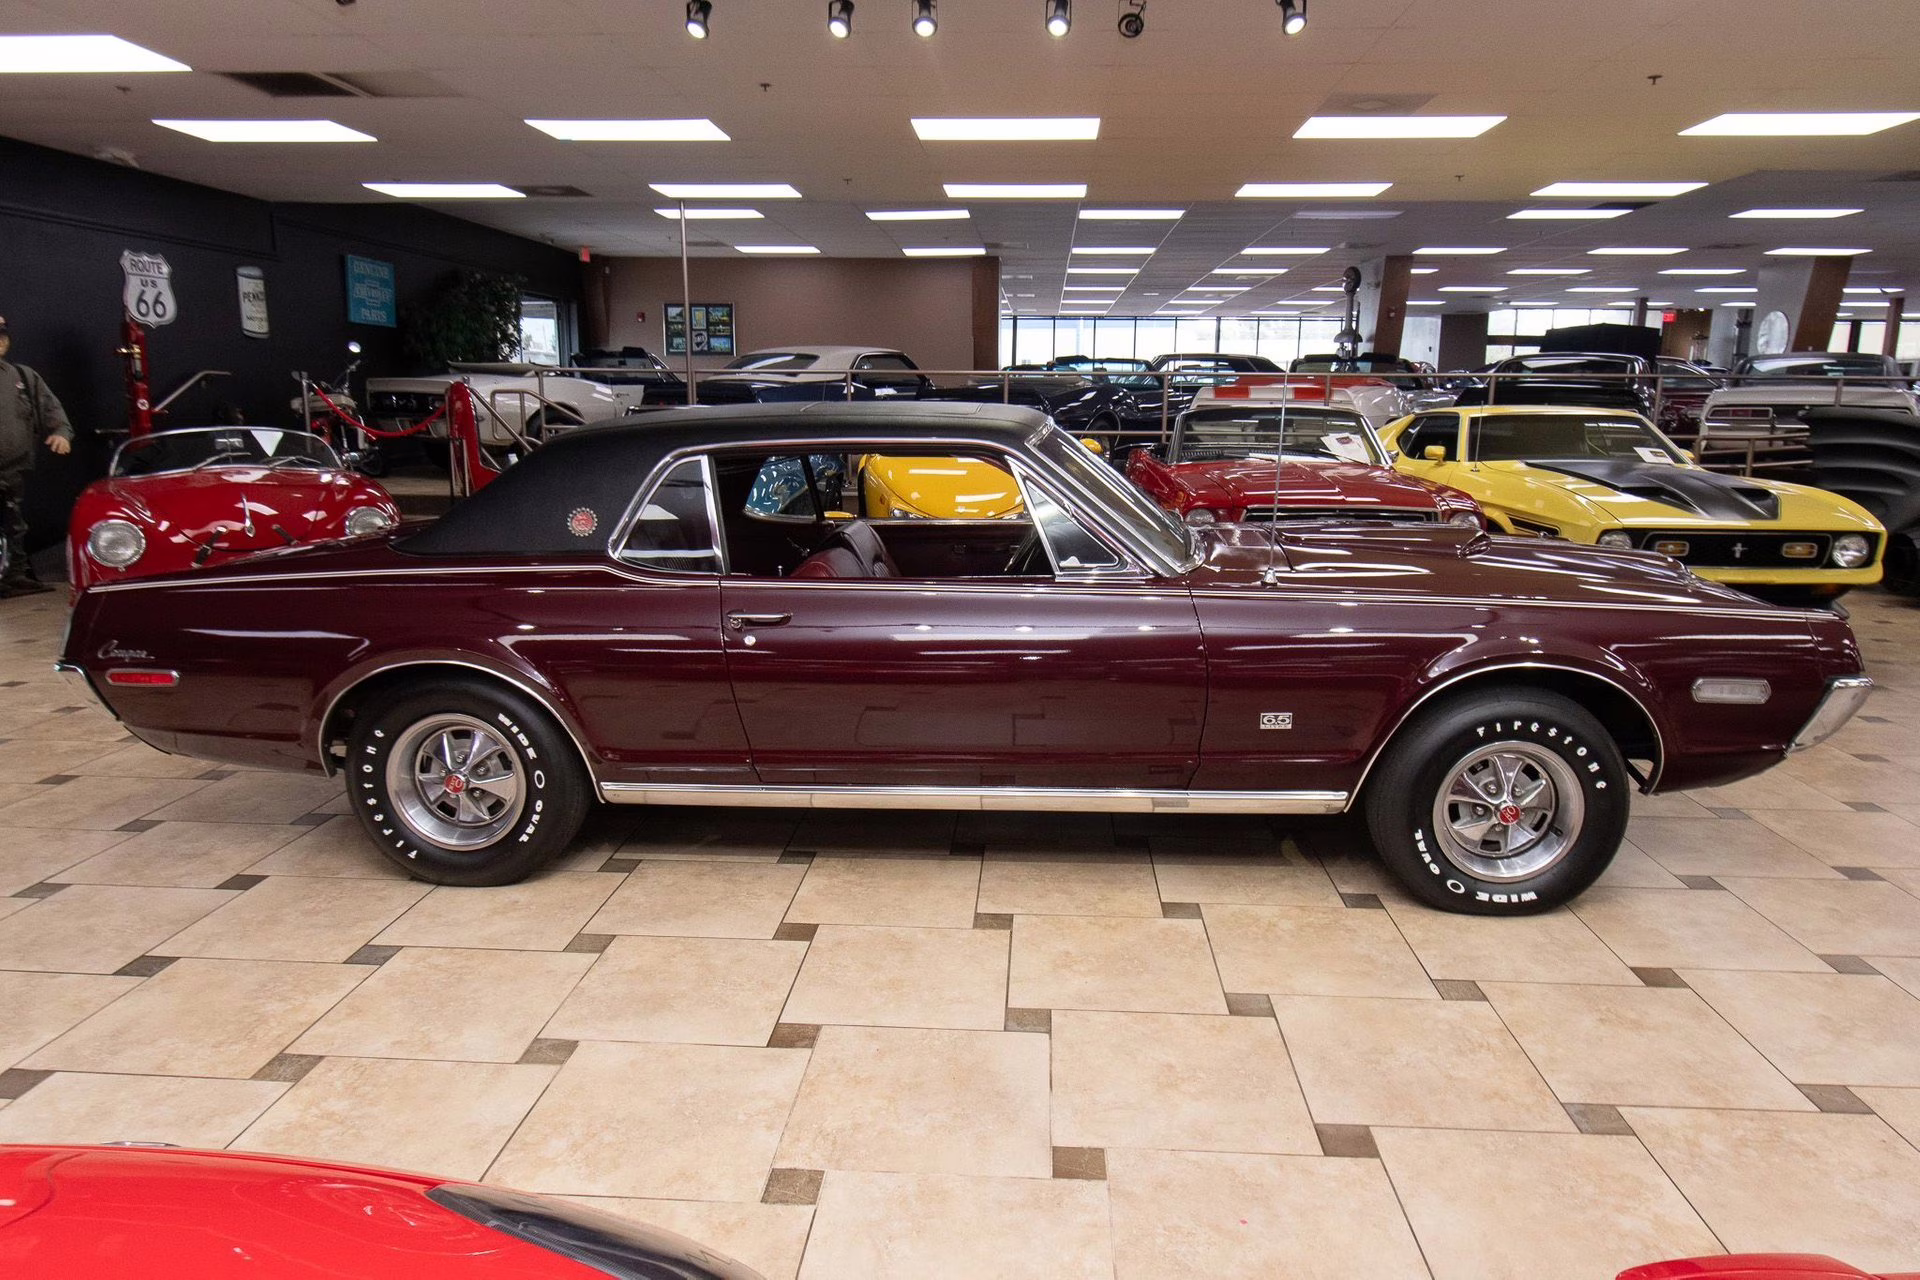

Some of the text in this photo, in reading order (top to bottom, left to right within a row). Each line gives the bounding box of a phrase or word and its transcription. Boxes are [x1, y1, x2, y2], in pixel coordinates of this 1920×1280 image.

[129, 259, 163, 275] ROUTE
[141, 279, 158, 288] US
[136, 289, 167, 318] 66
[361, 309, 387, 322] PARTS
[1262, 715, 1290, 725] 6.5
[497, 713, 537, 760] WIDE
[519, 799, 544, 843] OVAL
[1414, 828, 1441, 875] OVAL
[1475, 890, 1538, 903] WIDE
